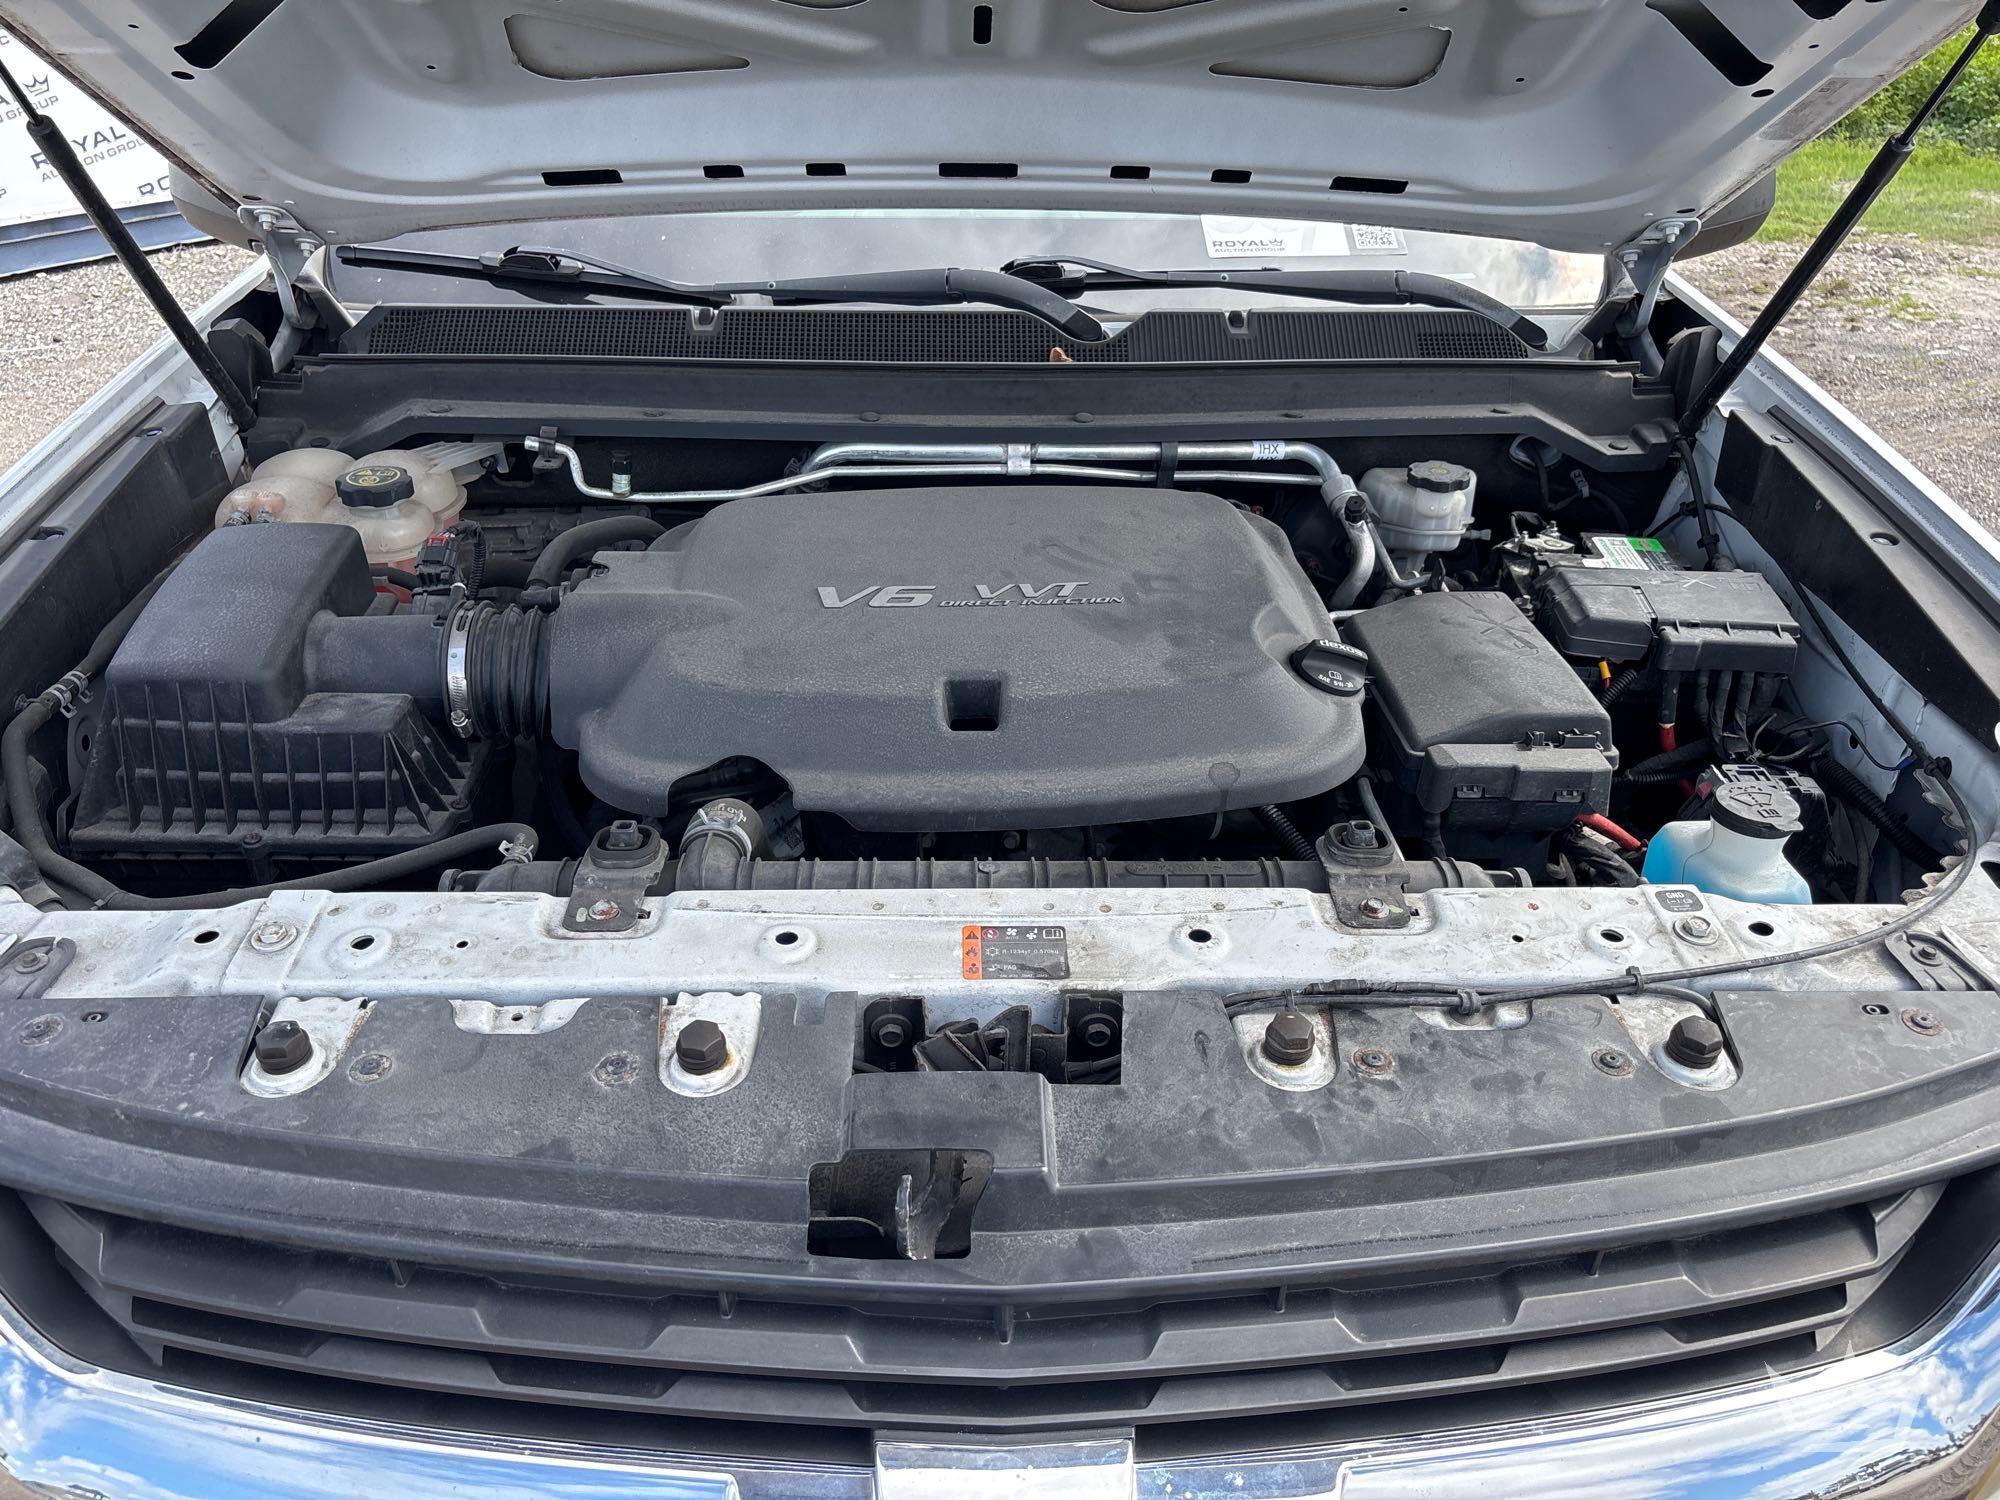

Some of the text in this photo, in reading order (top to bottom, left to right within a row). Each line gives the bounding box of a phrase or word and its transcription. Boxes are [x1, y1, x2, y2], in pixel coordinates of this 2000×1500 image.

[30, 126, 126, 169] RYAL
[42, 138, 146, 182] AUON GROU
[1212, 240, 1269, 248] ROYAL
[816, 581, 1090, 609] V6 VVT
[938, 596, 1125, 608] DIRECT INJECTION
[1319, 640, 1363, 656] dexos
[1317, 674, 1331, 684] SAE
